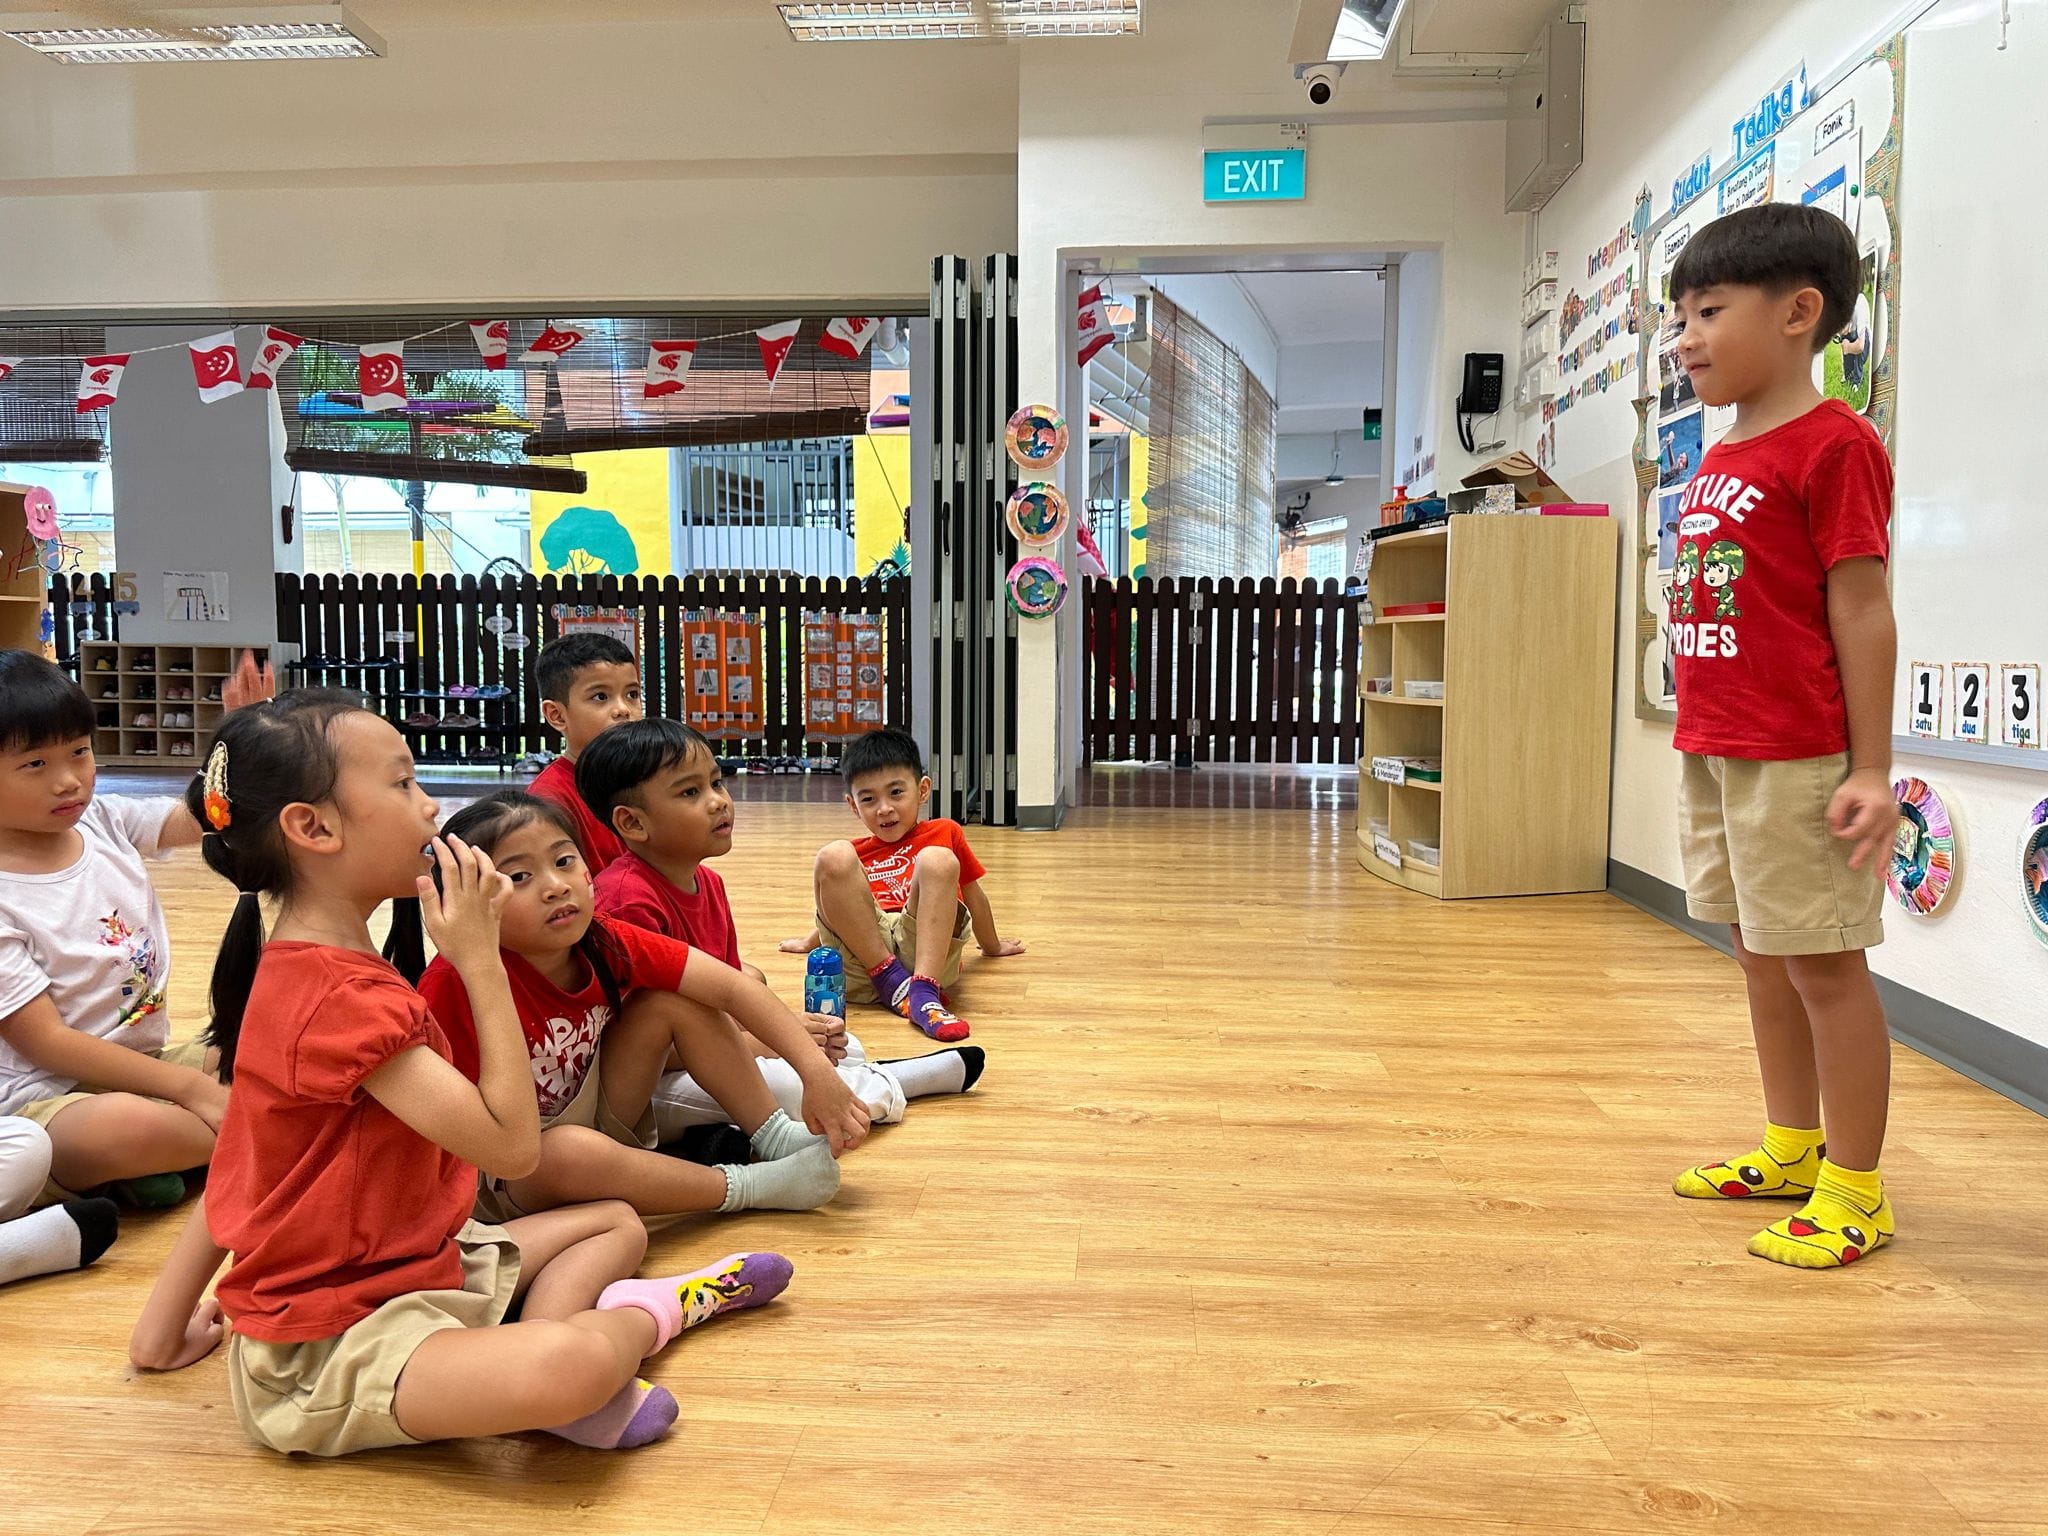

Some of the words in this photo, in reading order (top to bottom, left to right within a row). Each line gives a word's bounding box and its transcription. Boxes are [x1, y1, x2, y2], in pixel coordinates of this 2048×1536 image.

[1822, 115, 1843, 139] Fonik
[1671, 155, 1710, 215] Sudut
[1733, 80, 1793, 161] Tadika
[1224, 159, 1284, 193] EXIT
[1588, 221, 1630, 279] Integriti
[1679, 474, 1765, 523] UTURE
[551, 604, 595, 619] Chinese
[597, 605, 646, 622] Language
[1670, 623, 1738, 657] ROES
[1918, 672, 1932, 715] 1
[1963, 673, 1979, 717] 2
[2011, 674, 2029, 721] 3
[1915, 718, 1932, 731] satu
[1962, 720, 1976, 734] dua
[2012, 724, 2030, 744] tiga
